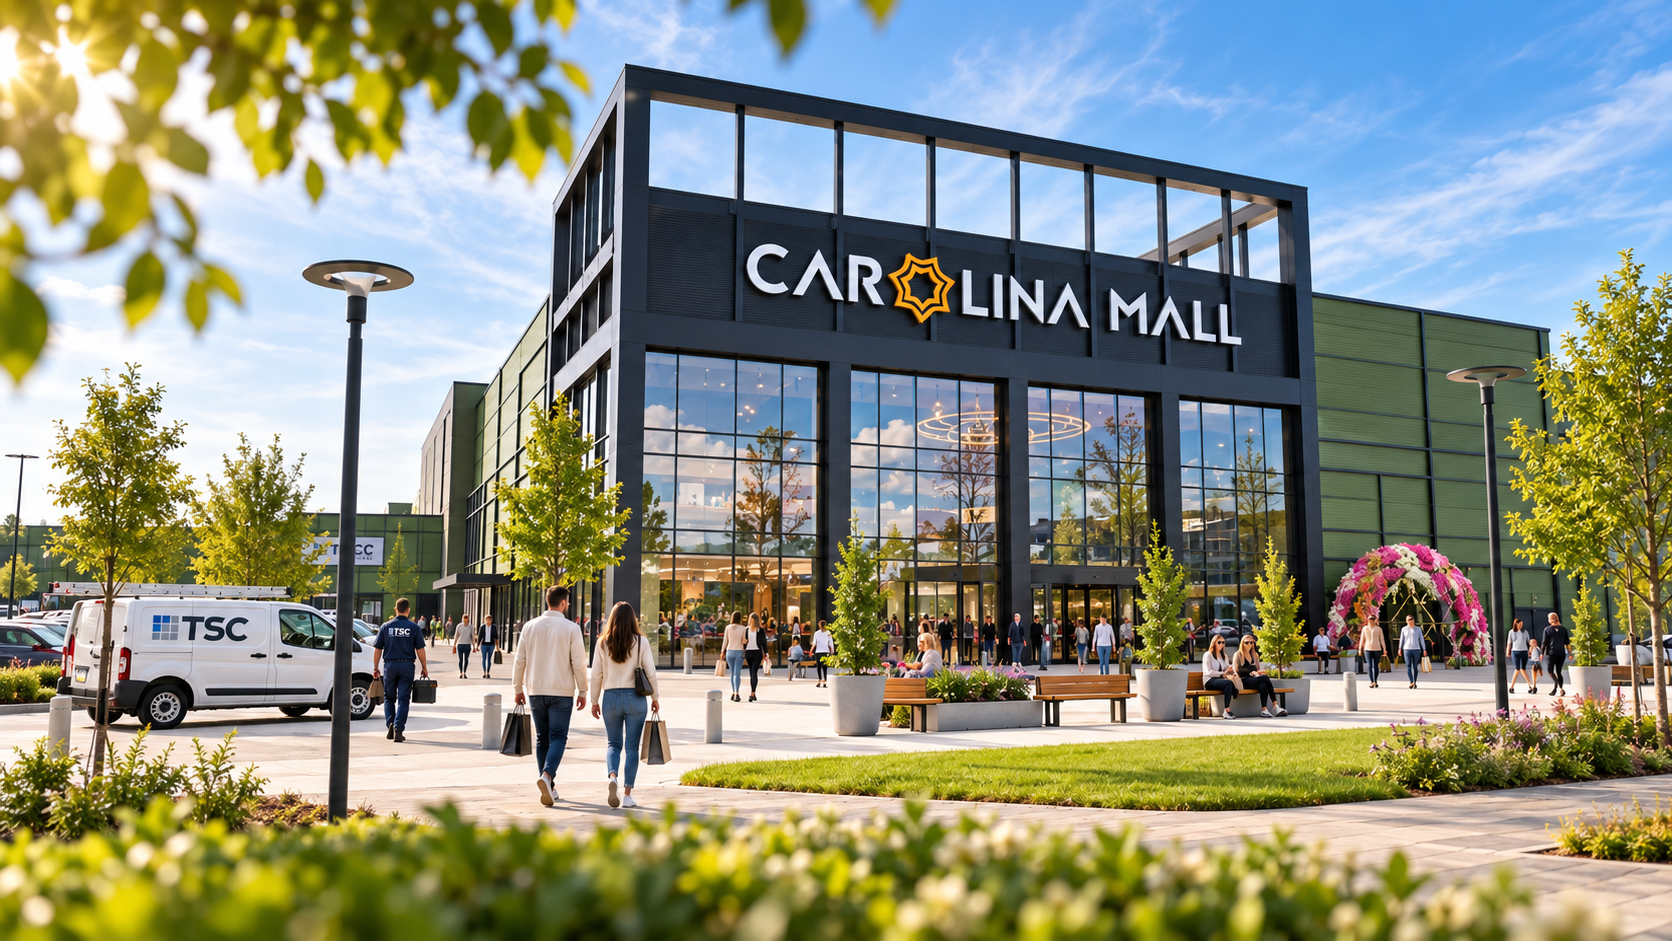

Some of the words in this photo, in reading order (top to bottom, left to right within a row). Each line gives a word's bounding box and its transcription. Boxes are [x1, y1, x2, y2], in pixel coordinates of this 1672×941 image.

[1109, 288, 1242, 345] MALL
[182, 616, 249, 641] TSC
[394, 627, 411, 636] TSC
